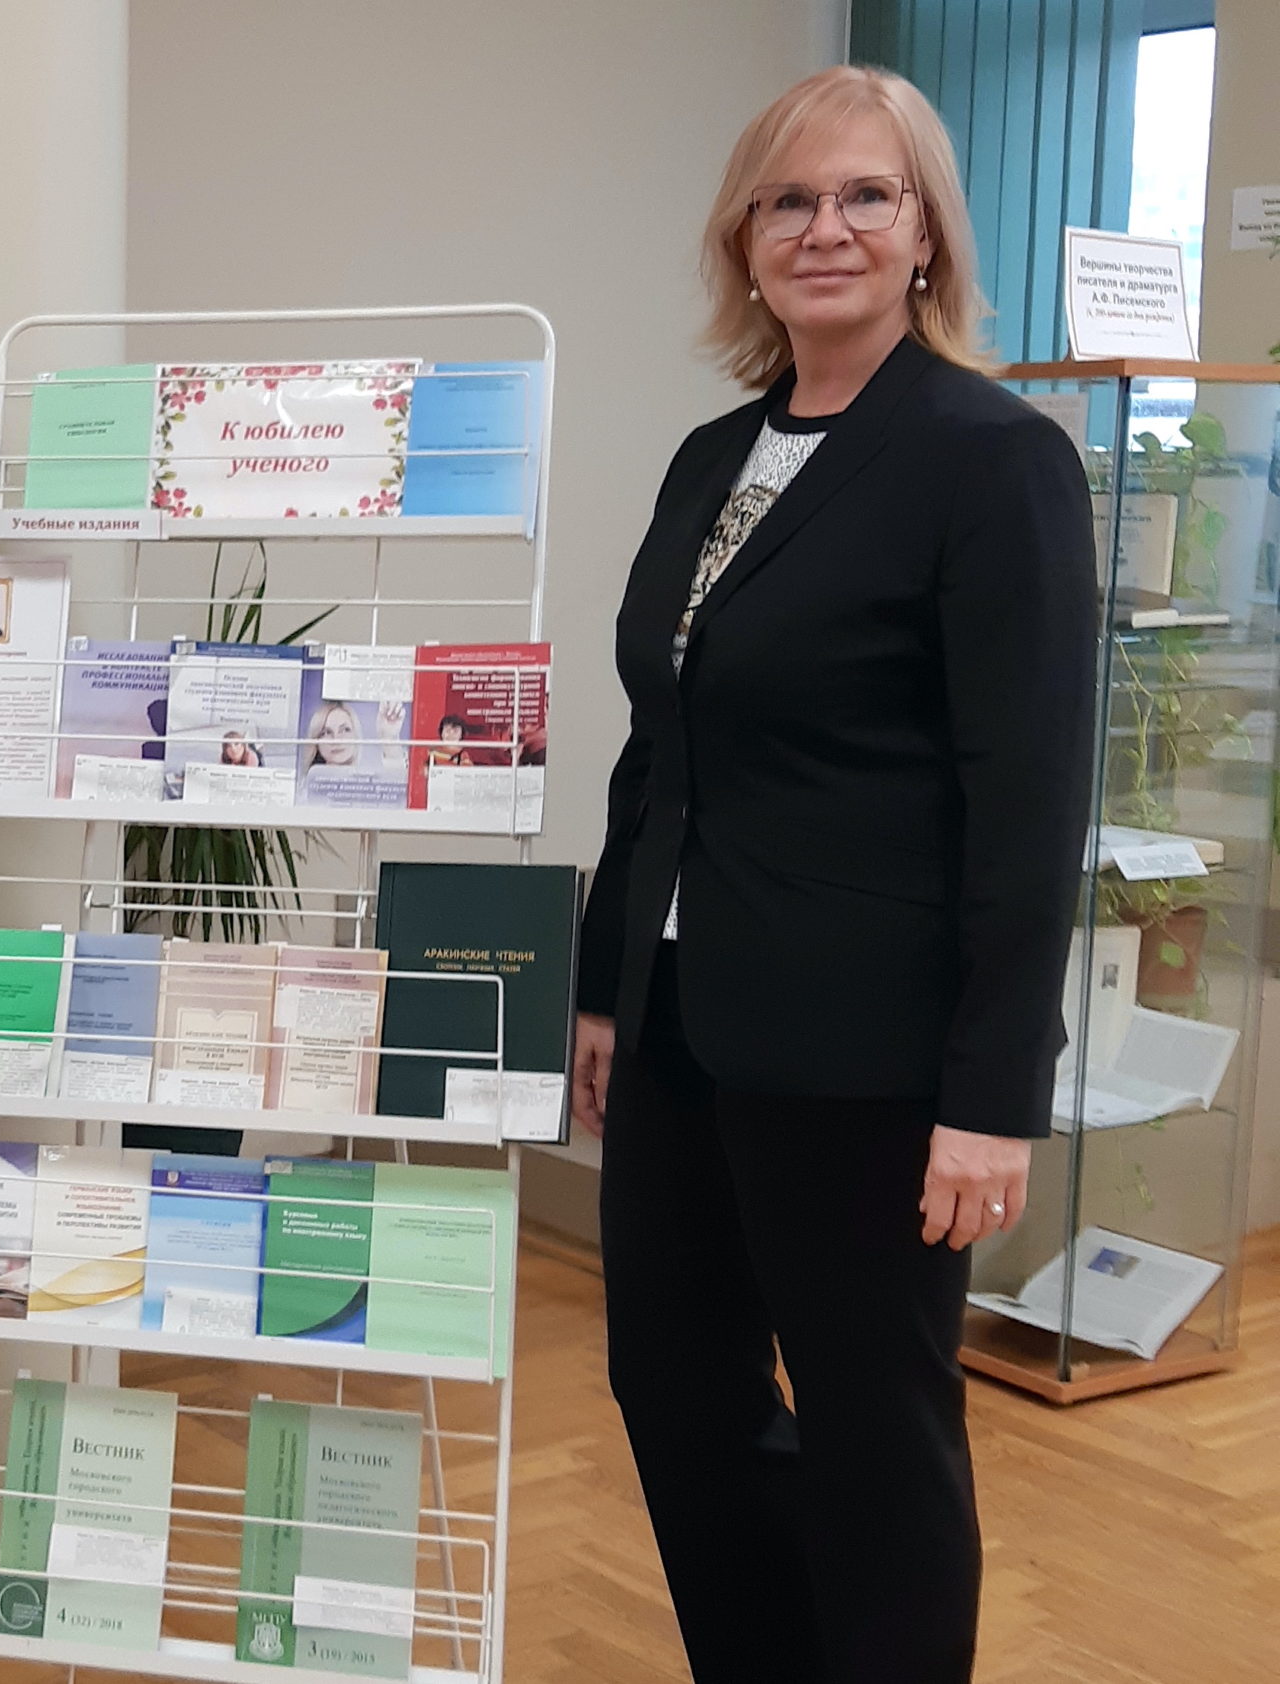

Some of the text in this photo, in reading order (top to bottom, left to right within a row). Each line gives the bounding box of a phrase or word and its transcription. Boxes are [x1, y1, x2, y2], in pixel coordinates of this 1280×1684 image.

[1080, 255, 1174, 278] Вершины творчества
[1077, 276, 1118, 289] писателя
[1128, 281, 1179, 295] драматурга
[1113, 295, 1166, 310] Писемского
[220, 421, 345, 441] К юбилею
[226, 456, 330, 478] ученого
[12, 517, 140, 532] Учебные издания
[423, 948, 536, 963] АРАКИНСКИЕ ЧТЕНИЯ
[72, 1437, 146, 1460] ВЕСТНИК
[320, 1446, 393, 1469] ВЕСТНИК
[70, 1467, 133, 1484] Московского
[68, 1483, 122, 1496] городского
[57, 1607, 66, 1623] 4
[71, 1614, 91, 1629] (32)
[99, 1617, 123, 1630] 2018
[307, 1640, 317, 1657] 3
[320, 1646, 342, 1661] (19)
